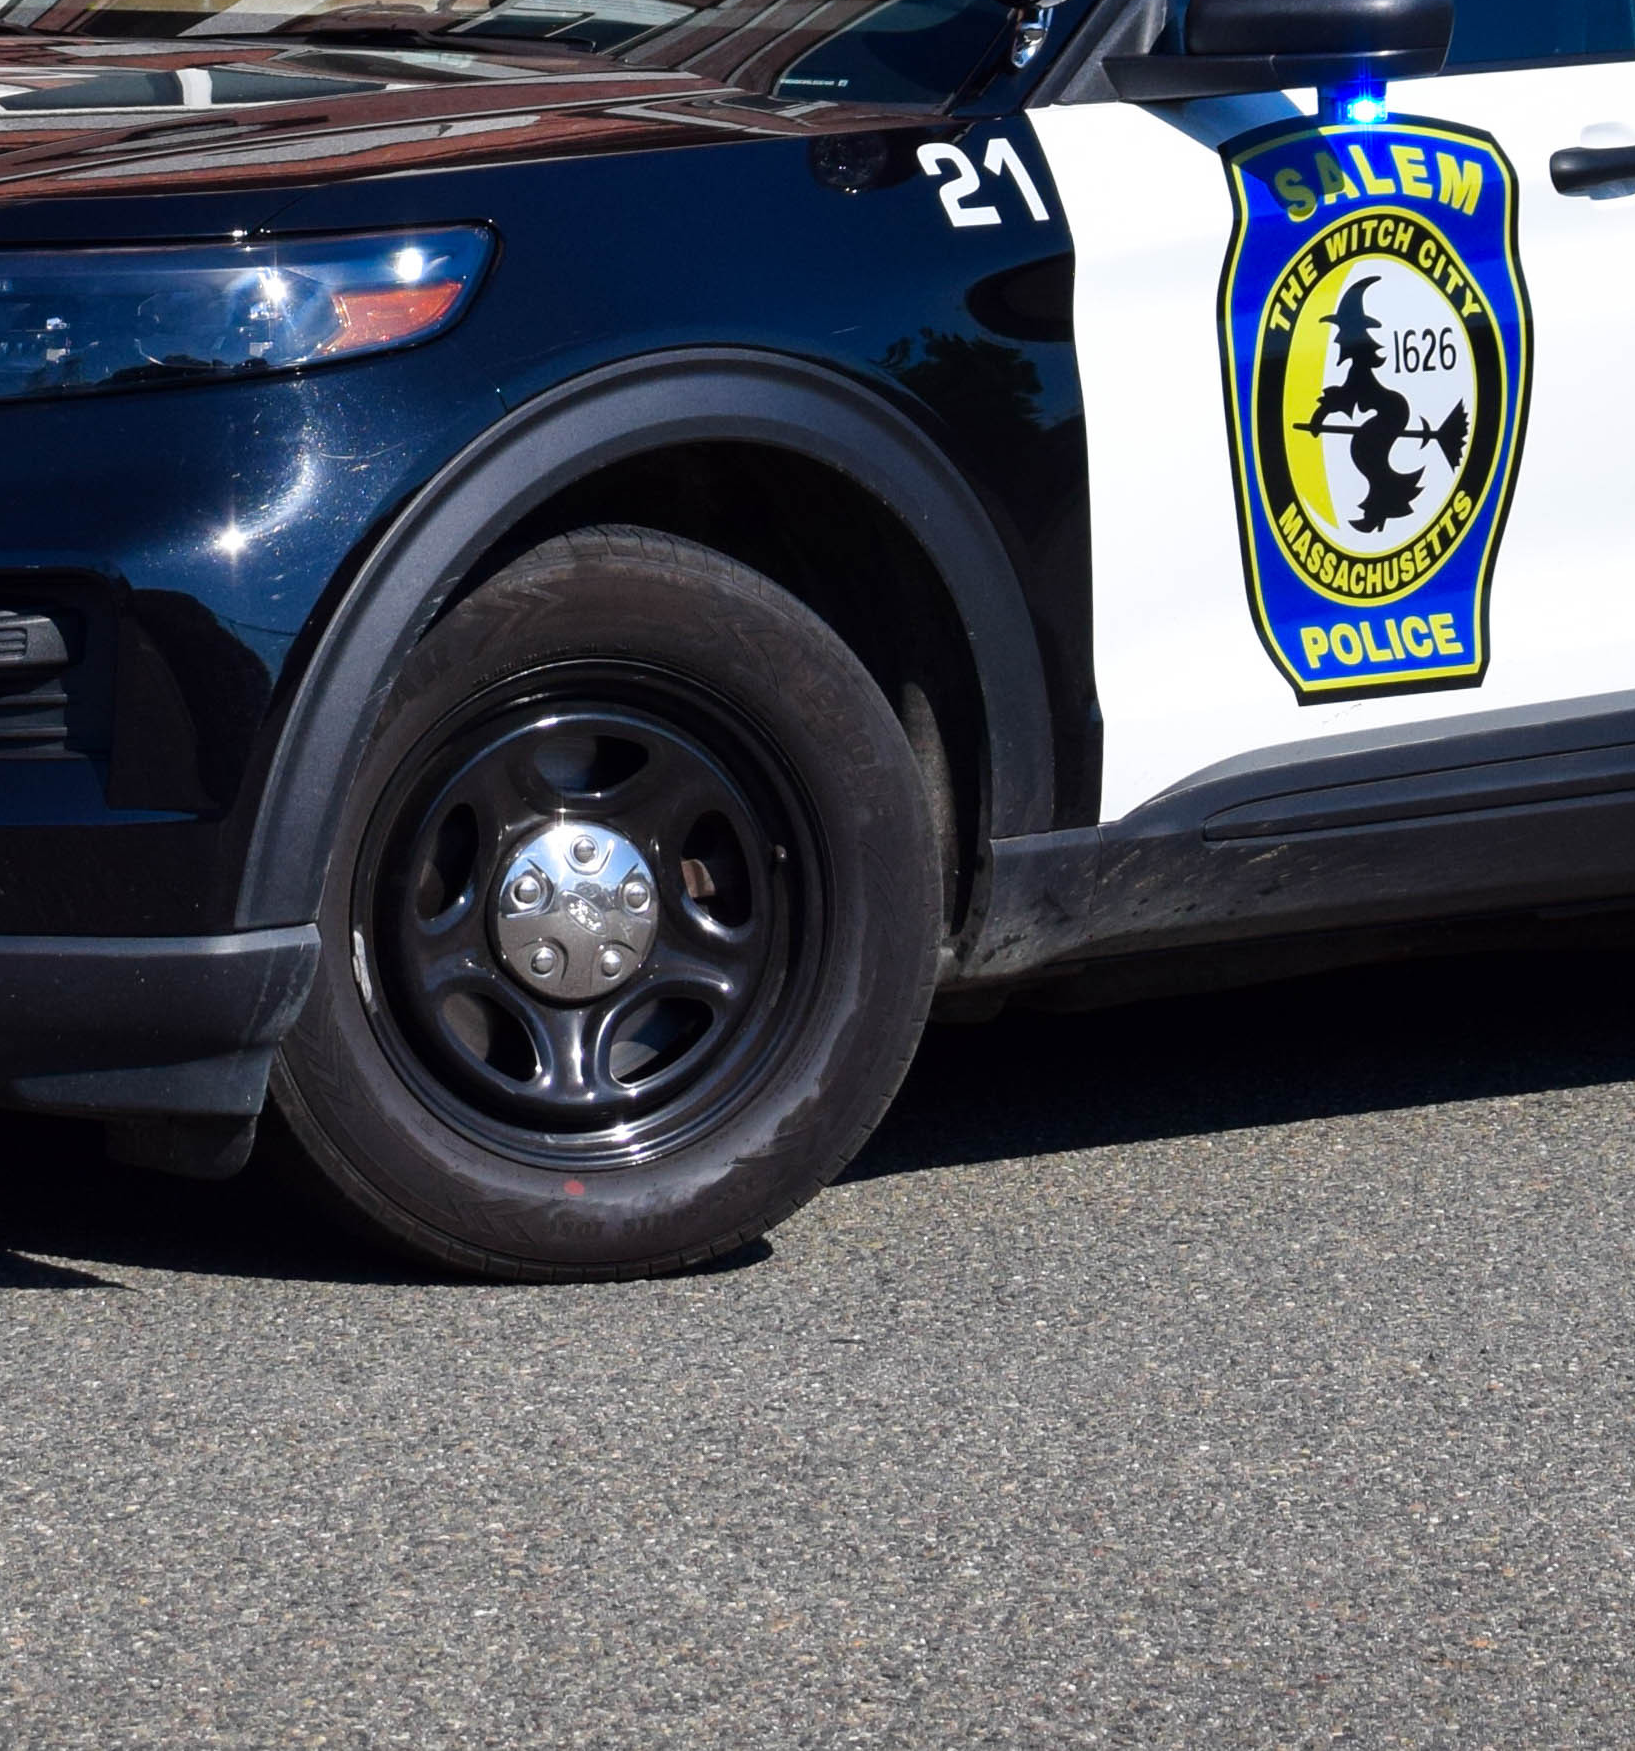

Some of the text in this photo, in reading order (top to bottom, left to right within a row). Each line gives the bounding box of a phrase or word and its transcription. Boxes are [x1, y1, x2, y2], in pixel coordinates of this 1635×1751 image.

[915, 137, 1051, 229] 21
[1272, 144, 1483, 223] SALEM
[1268, 219, 1483, 335] THE WITCH CITY
[1392, 328, 1458, 375] 1626
[1277, 489, 1474, 597] MASSACHUSETTS
[1300, 612, 1464, 670] POLICE
